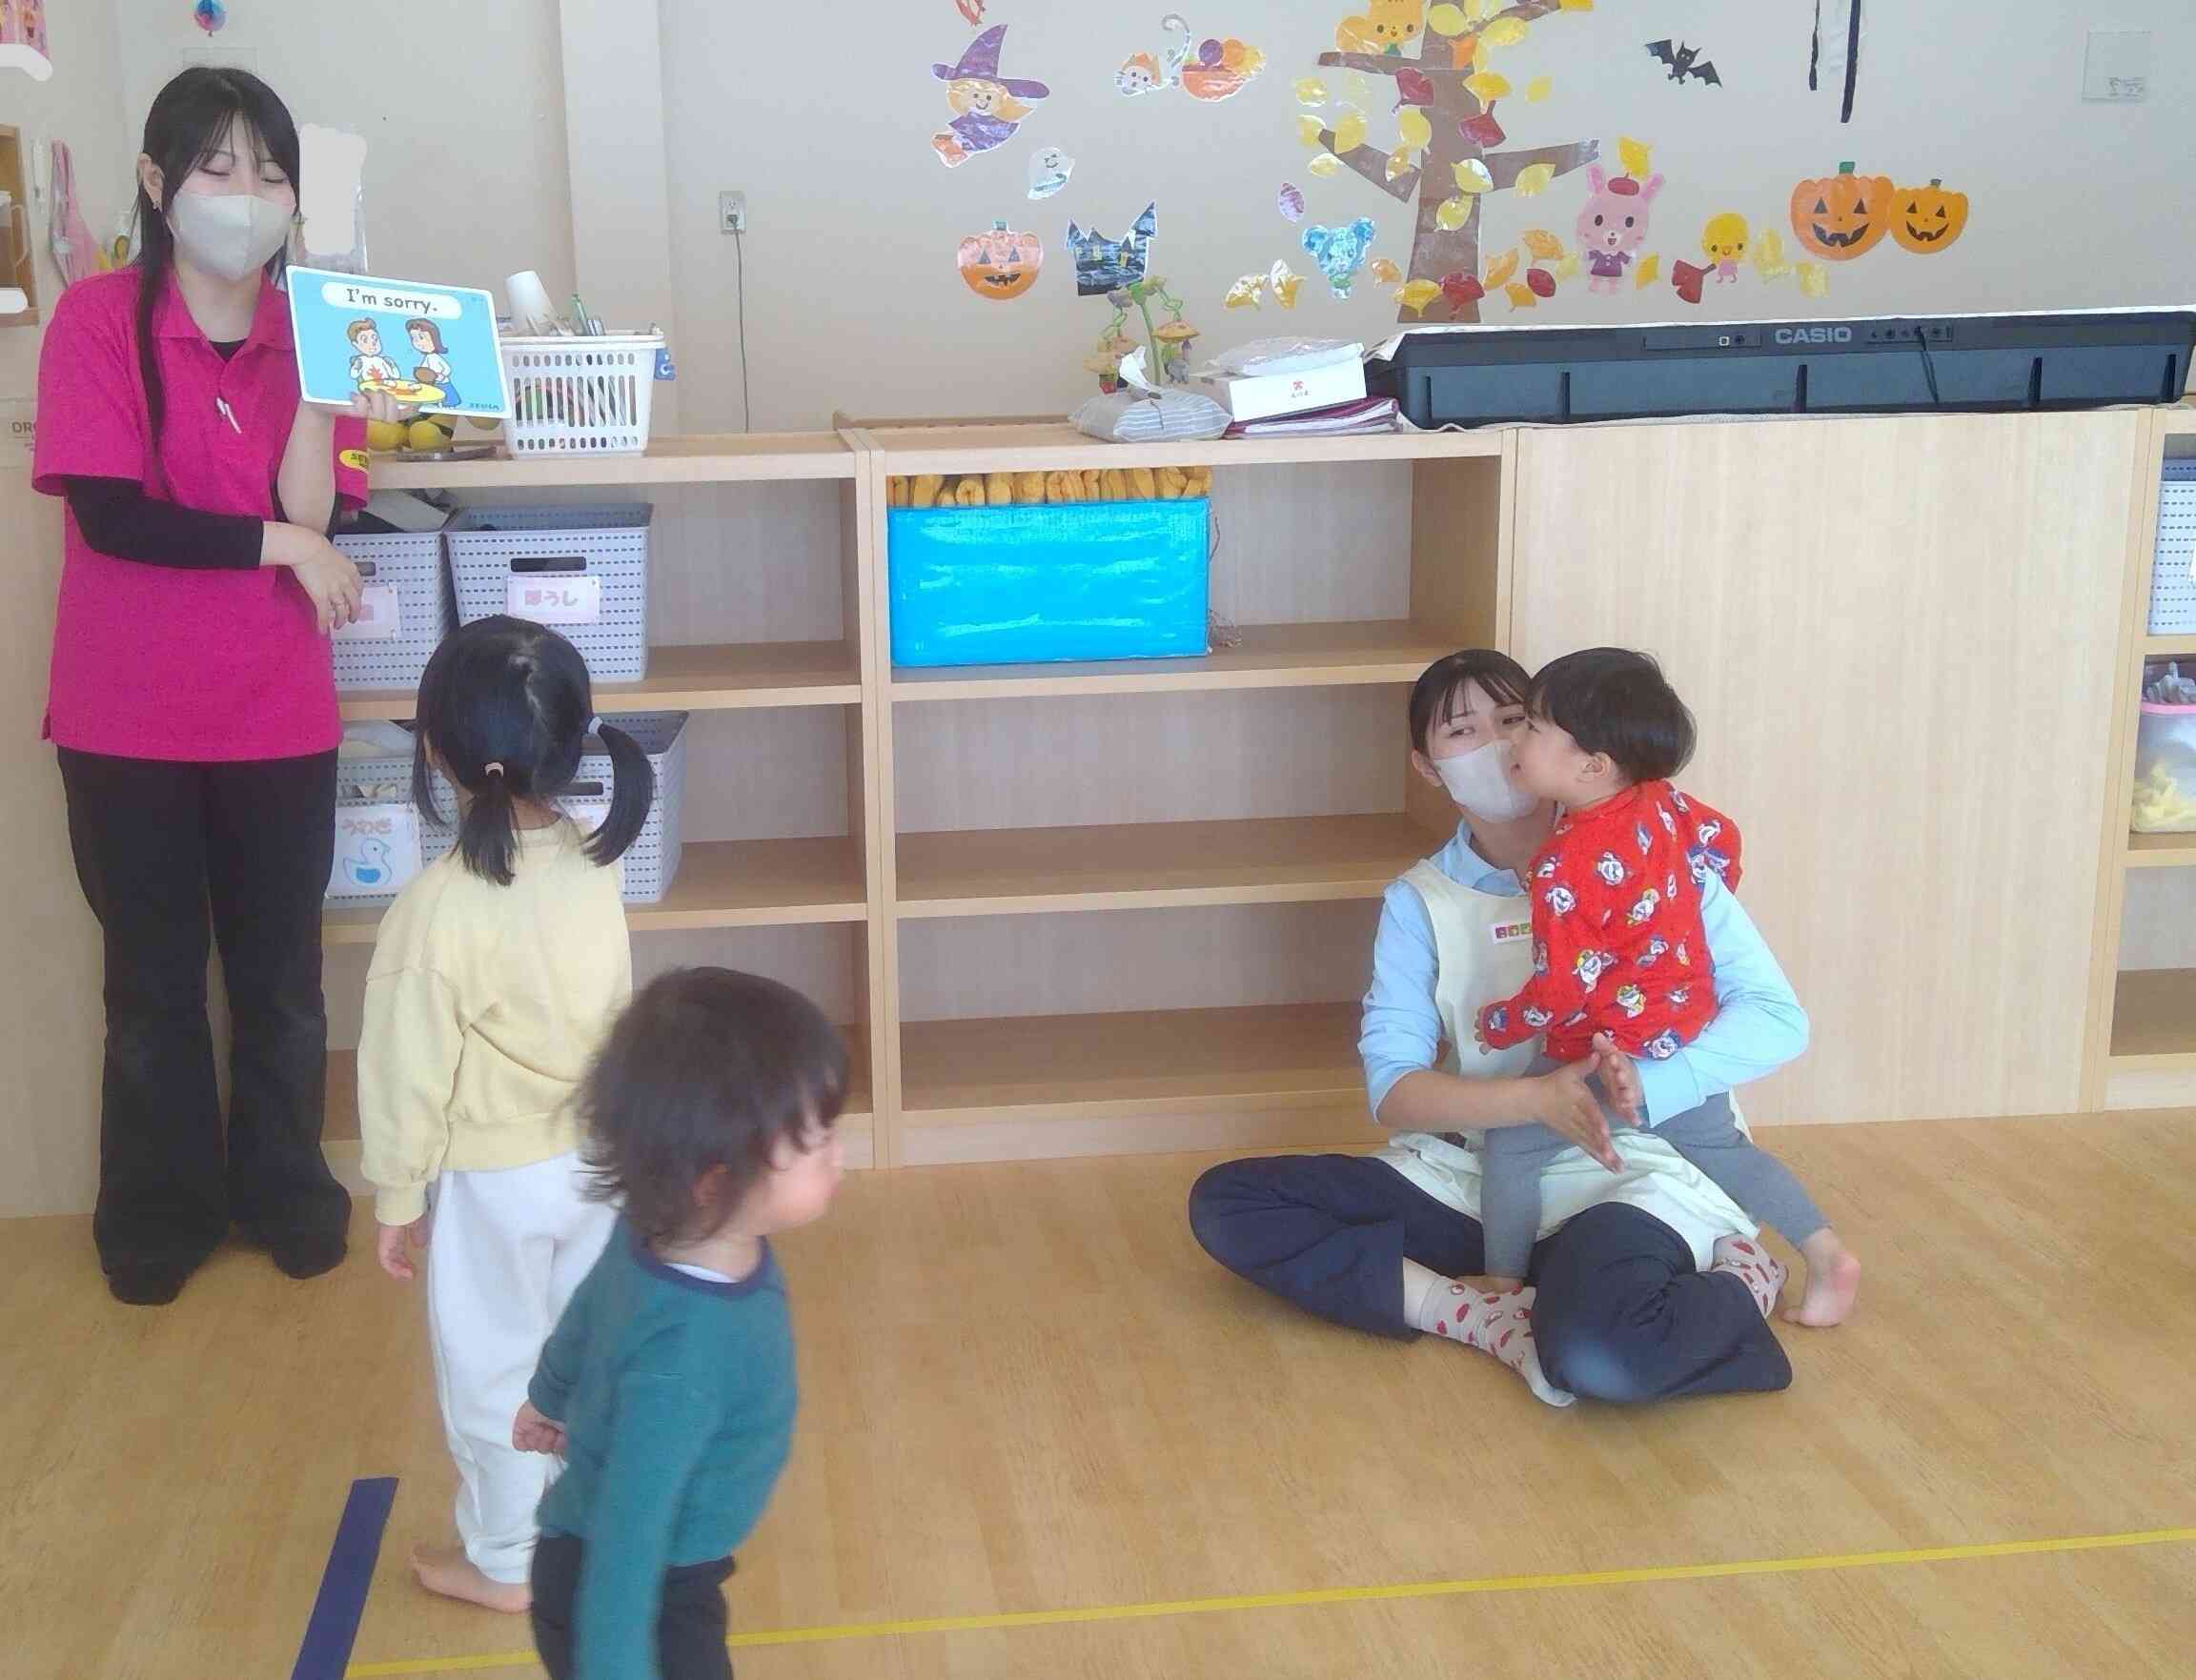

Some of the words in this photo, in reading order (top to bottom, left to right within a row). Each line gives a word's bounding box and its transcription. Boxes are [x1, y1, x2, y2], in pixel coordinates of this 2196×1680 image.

[346, 288, 377, 306] I'm
[383, 295, 438, 314] sorry.
[1775, 327, 1852, 344] CASIO
